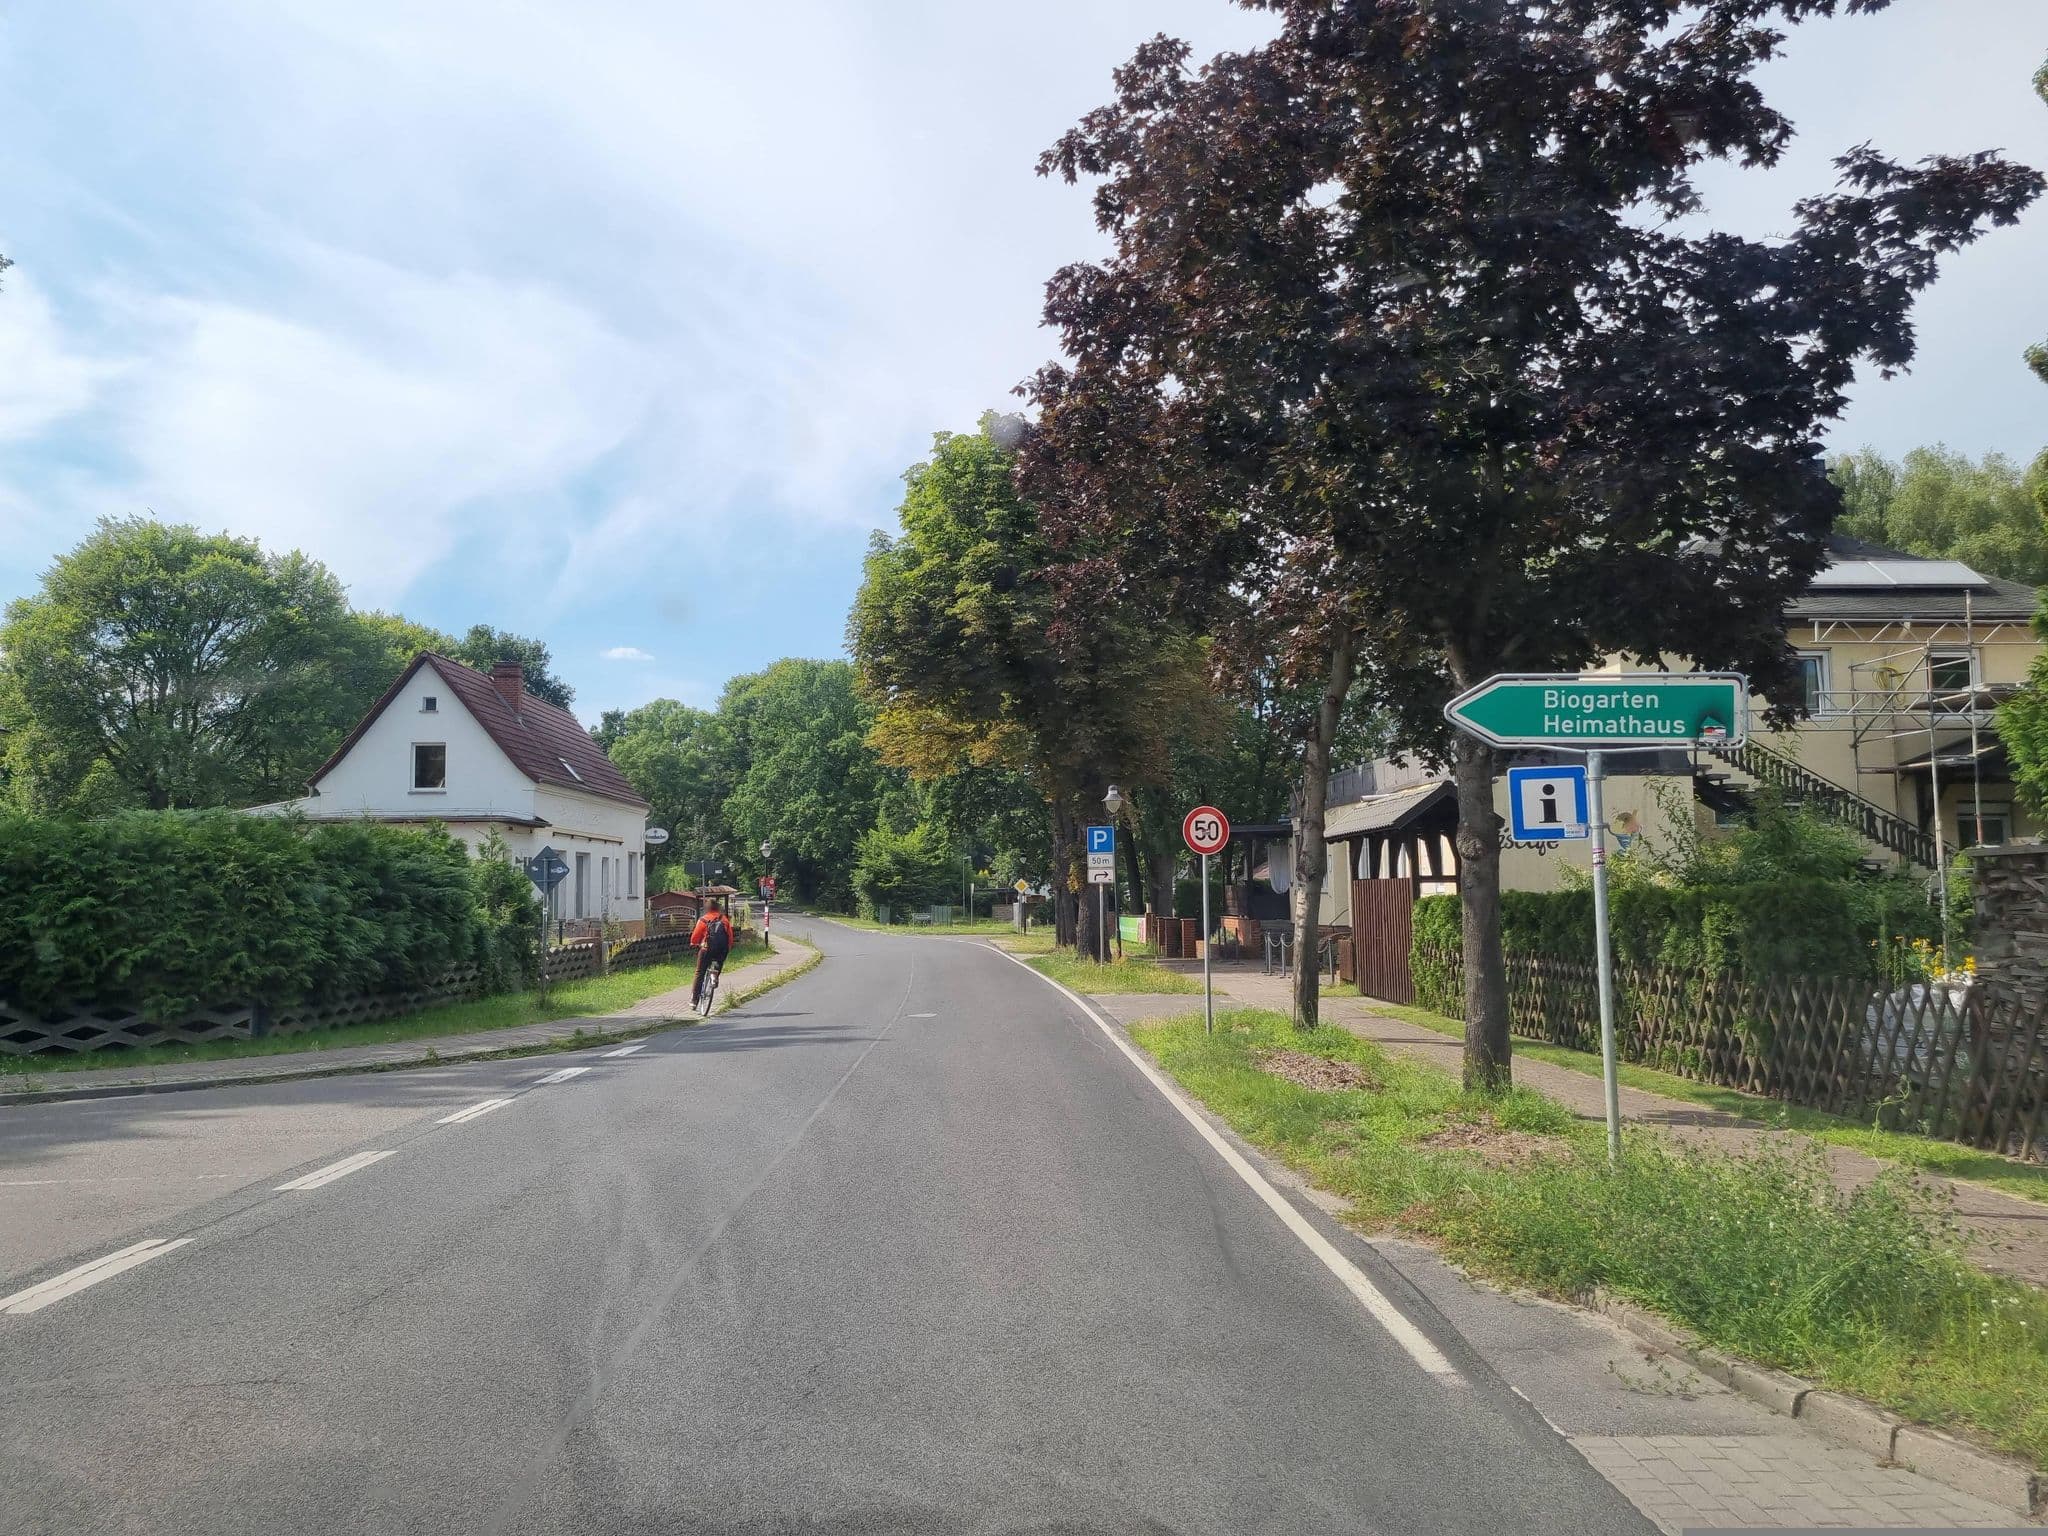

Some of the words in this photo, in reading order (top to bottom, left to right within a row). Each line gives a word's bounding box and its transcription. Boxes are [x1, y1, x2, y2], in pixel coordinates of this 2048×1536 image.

[1544, 690, 1659, 713] Biogarten
[1544, 715, 1686, 733] Heimathaus
[1093, 830, 1107, 850] P
[1195, 820, 1219, 841] 50
[1091, 857, 1101, 865] 50
